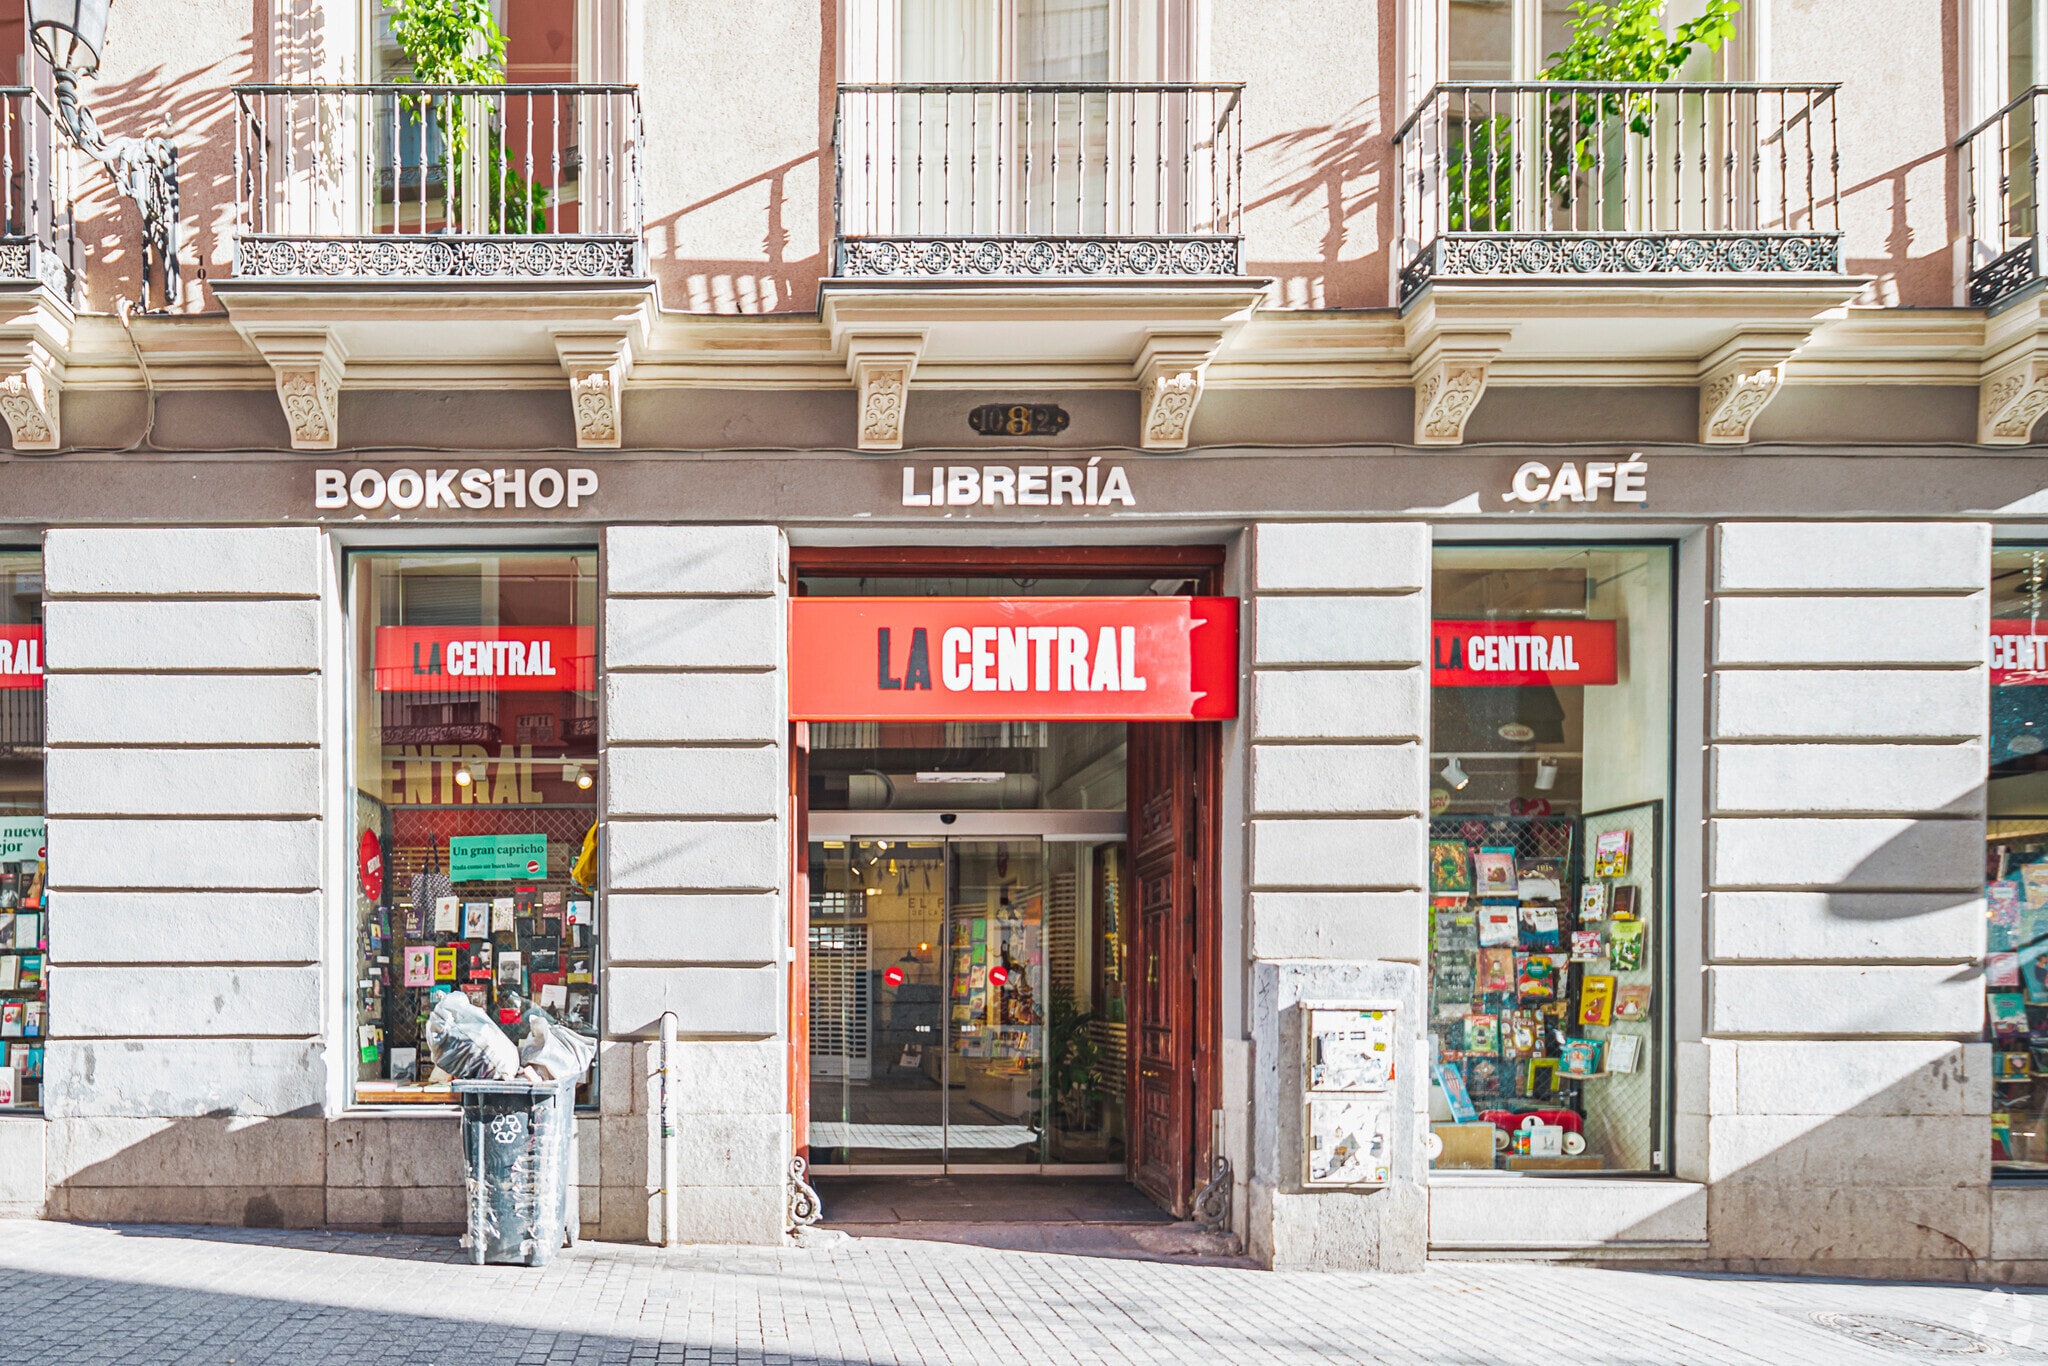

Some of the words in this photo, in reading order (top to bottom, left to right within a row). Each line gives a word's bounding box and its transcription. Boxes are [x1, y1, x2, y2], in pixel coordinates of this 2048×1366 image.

[315, 467, 600, 509] BOOKSHOP
[902, 456, 1136, 507] LIBRERÍA
[1510, 453, 1648, 503] CAFÉ
[412, 641, 441, 676] LA
[446, 640, 556, 677] CENTRAL
[877, 626, 933, 691] LA
[942, 626, 1147, 692] CENTRAL
[1433, 636, 1463, 670] LA
[1467, 635, 1580, 672] CENTRAL
[1989, 634, 2048, 671] CENT
[3, 827, 46, 838] nuevo
[452, 846, 468, 856] Un
[470, 846, 495, 858] gran
[497, 843, 545, 856] capricho
